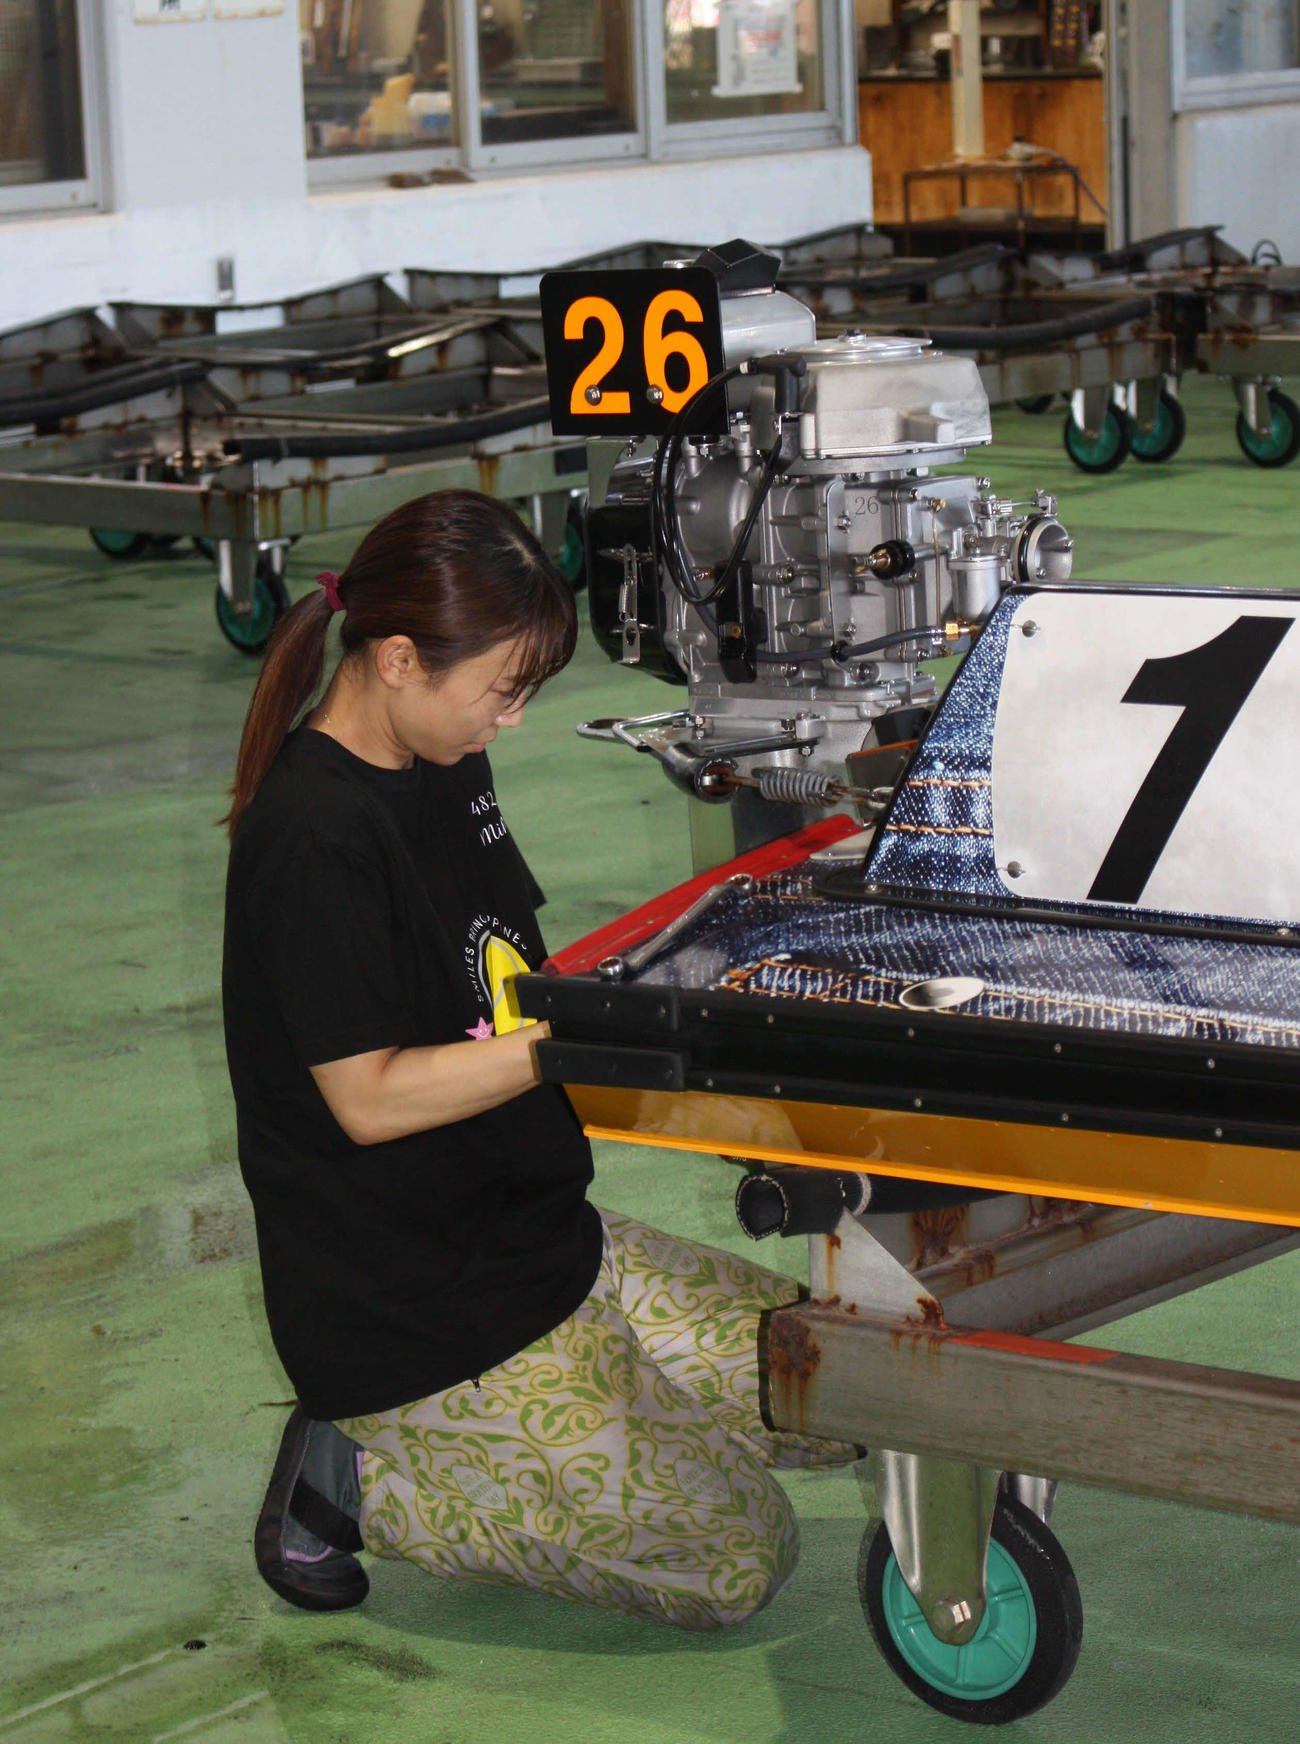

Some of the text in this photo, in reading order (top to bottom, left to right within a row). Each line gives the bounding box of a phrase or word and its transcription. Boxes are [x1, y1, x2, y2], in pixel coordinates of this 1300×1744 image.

[564, 289, 709, 414] 26
[855, 495, 879, 515] 26
[1087, 614, 1297, 904] 1
[464, 947, 485, 1002] SMILES
